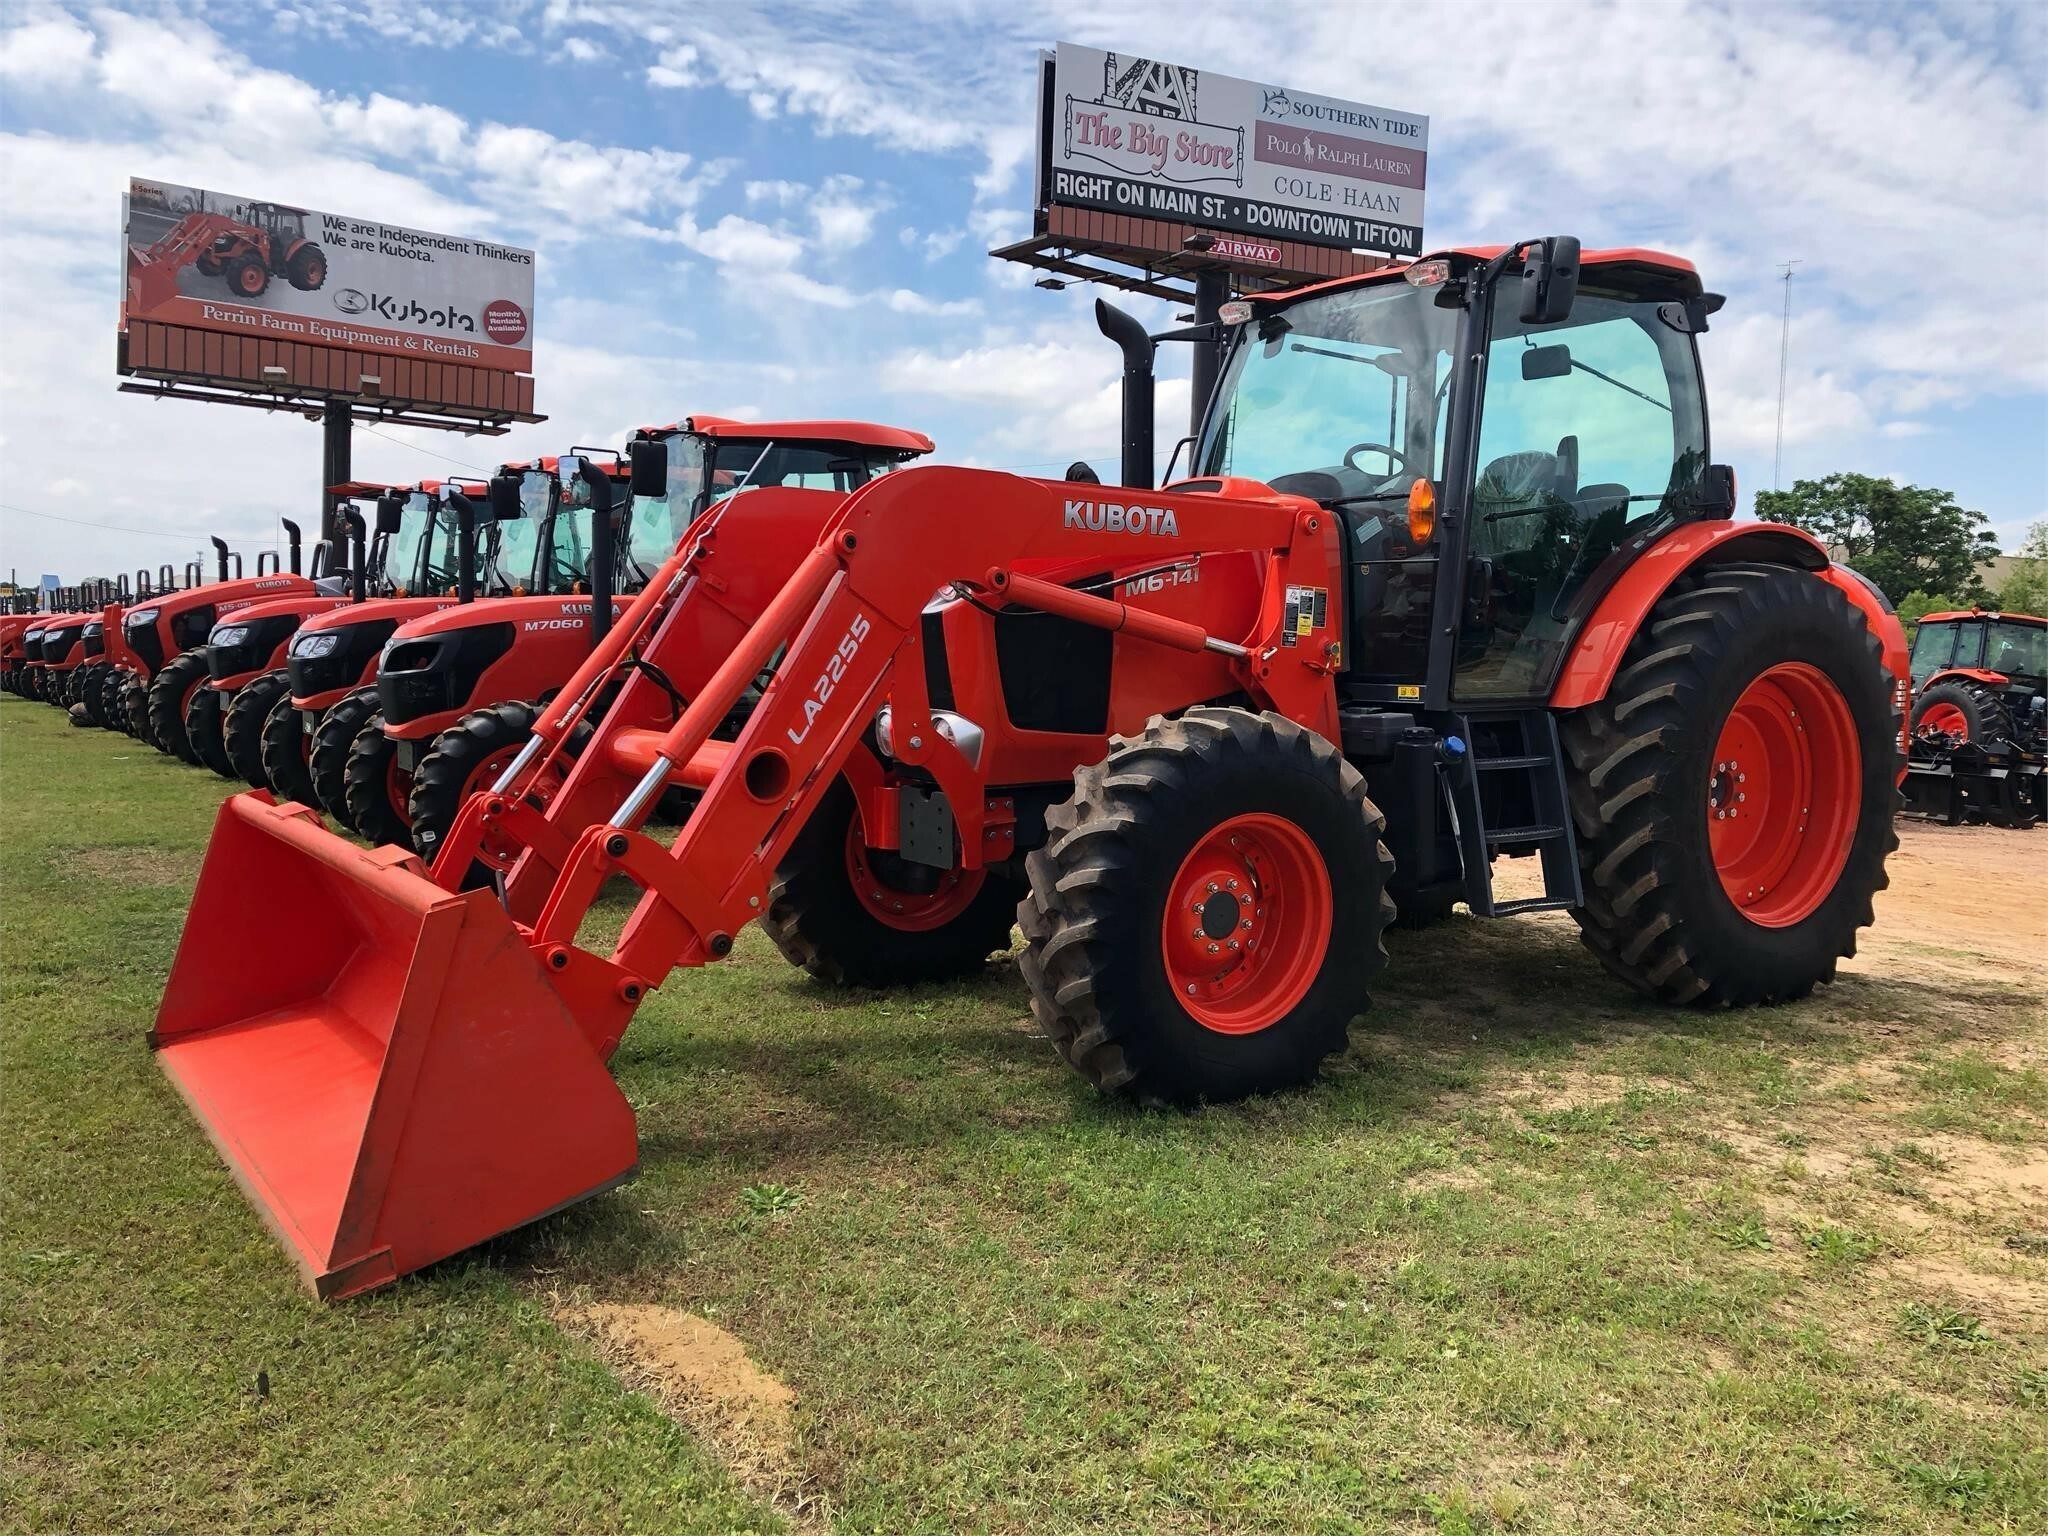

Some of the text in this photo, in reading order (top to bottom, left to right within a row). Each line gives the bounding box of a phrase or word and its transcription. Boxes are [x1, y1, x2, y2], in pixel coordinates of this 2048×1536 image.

[1293, 101, 1420, 138] SOUTHERN TIDE
[1075, 111, 1235, 171] The Big Store
[1056, 172, 1413, 249] RIGHT ON MAIN ST. DOWNTOWN TIFTON
[1274, 176, 1401, 214] COLE HAAN
[322, 215, 531, 265] We are Independent Thinkers
[322, 230, 435, 263] We are Kubota.
[203, 304, 479, 359] Perrin Farm Equipment & Rentals
[371, 293, 475, 333] Kubota
[488, 311, 521, 319] Monthly
[1064, 500, 1180, 537] KUBOTA
[254, 579, 292, 591] KUBOTA
[524, 619, 584, 631] M7060
[561, 603, 622, 615] KUBA
[786, 612, 871, 745] LA2255
